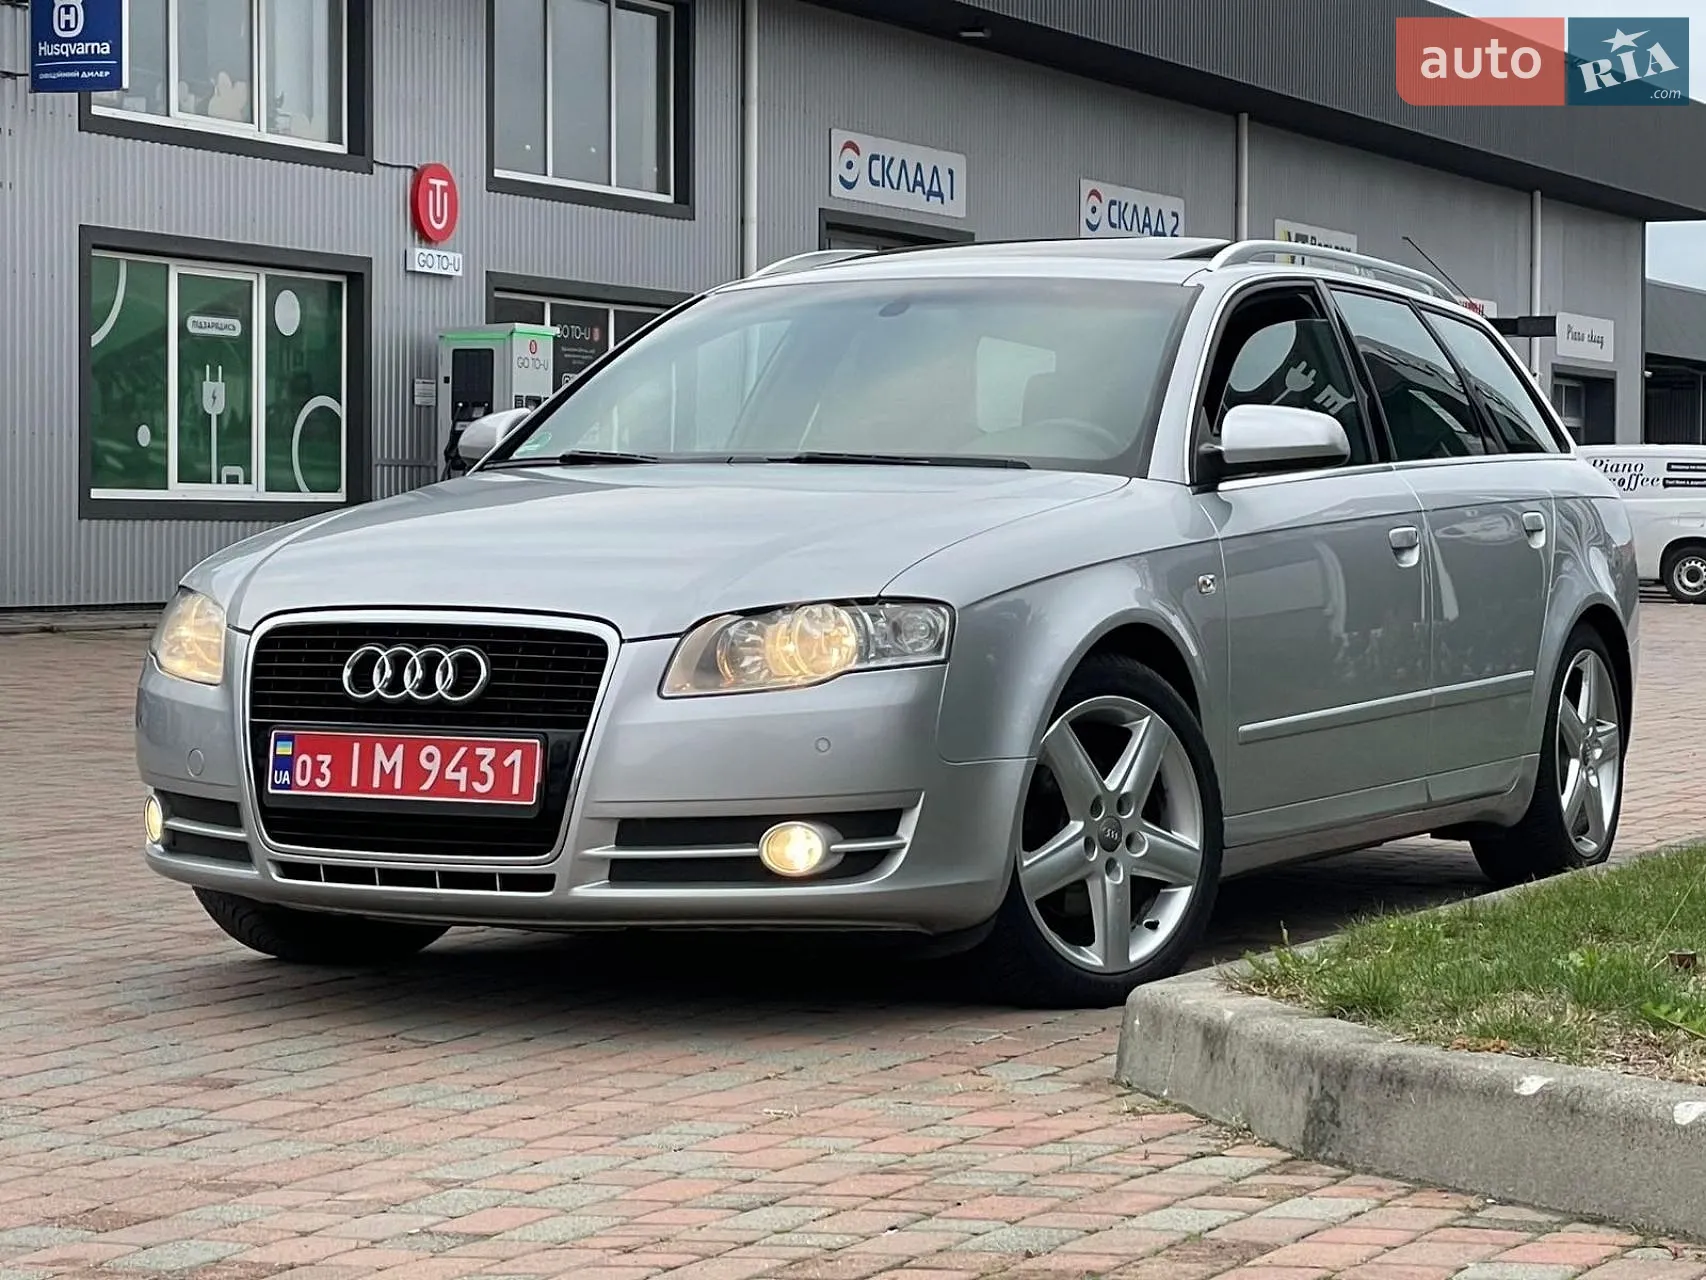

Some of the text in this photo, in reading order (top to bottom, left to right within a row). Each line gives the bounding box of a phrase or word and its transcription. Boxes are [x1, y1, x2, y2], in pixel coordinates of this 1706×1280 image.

[38, 41, 111, 57] Husqvarna
[81, 70, 110, 78] ДИЛЕР
[868, 153, 954, 205] СКЛАД 1
[1108, 199, 1180, 237] СКЛАД 2
[417, 252, 460, 272] GO TO-U
[517, 357, 530, 369] GO
[274, 770, 291, 786] UA
[295, 753, 333, 789] 03
[418, 744, 523, 796] 9431
